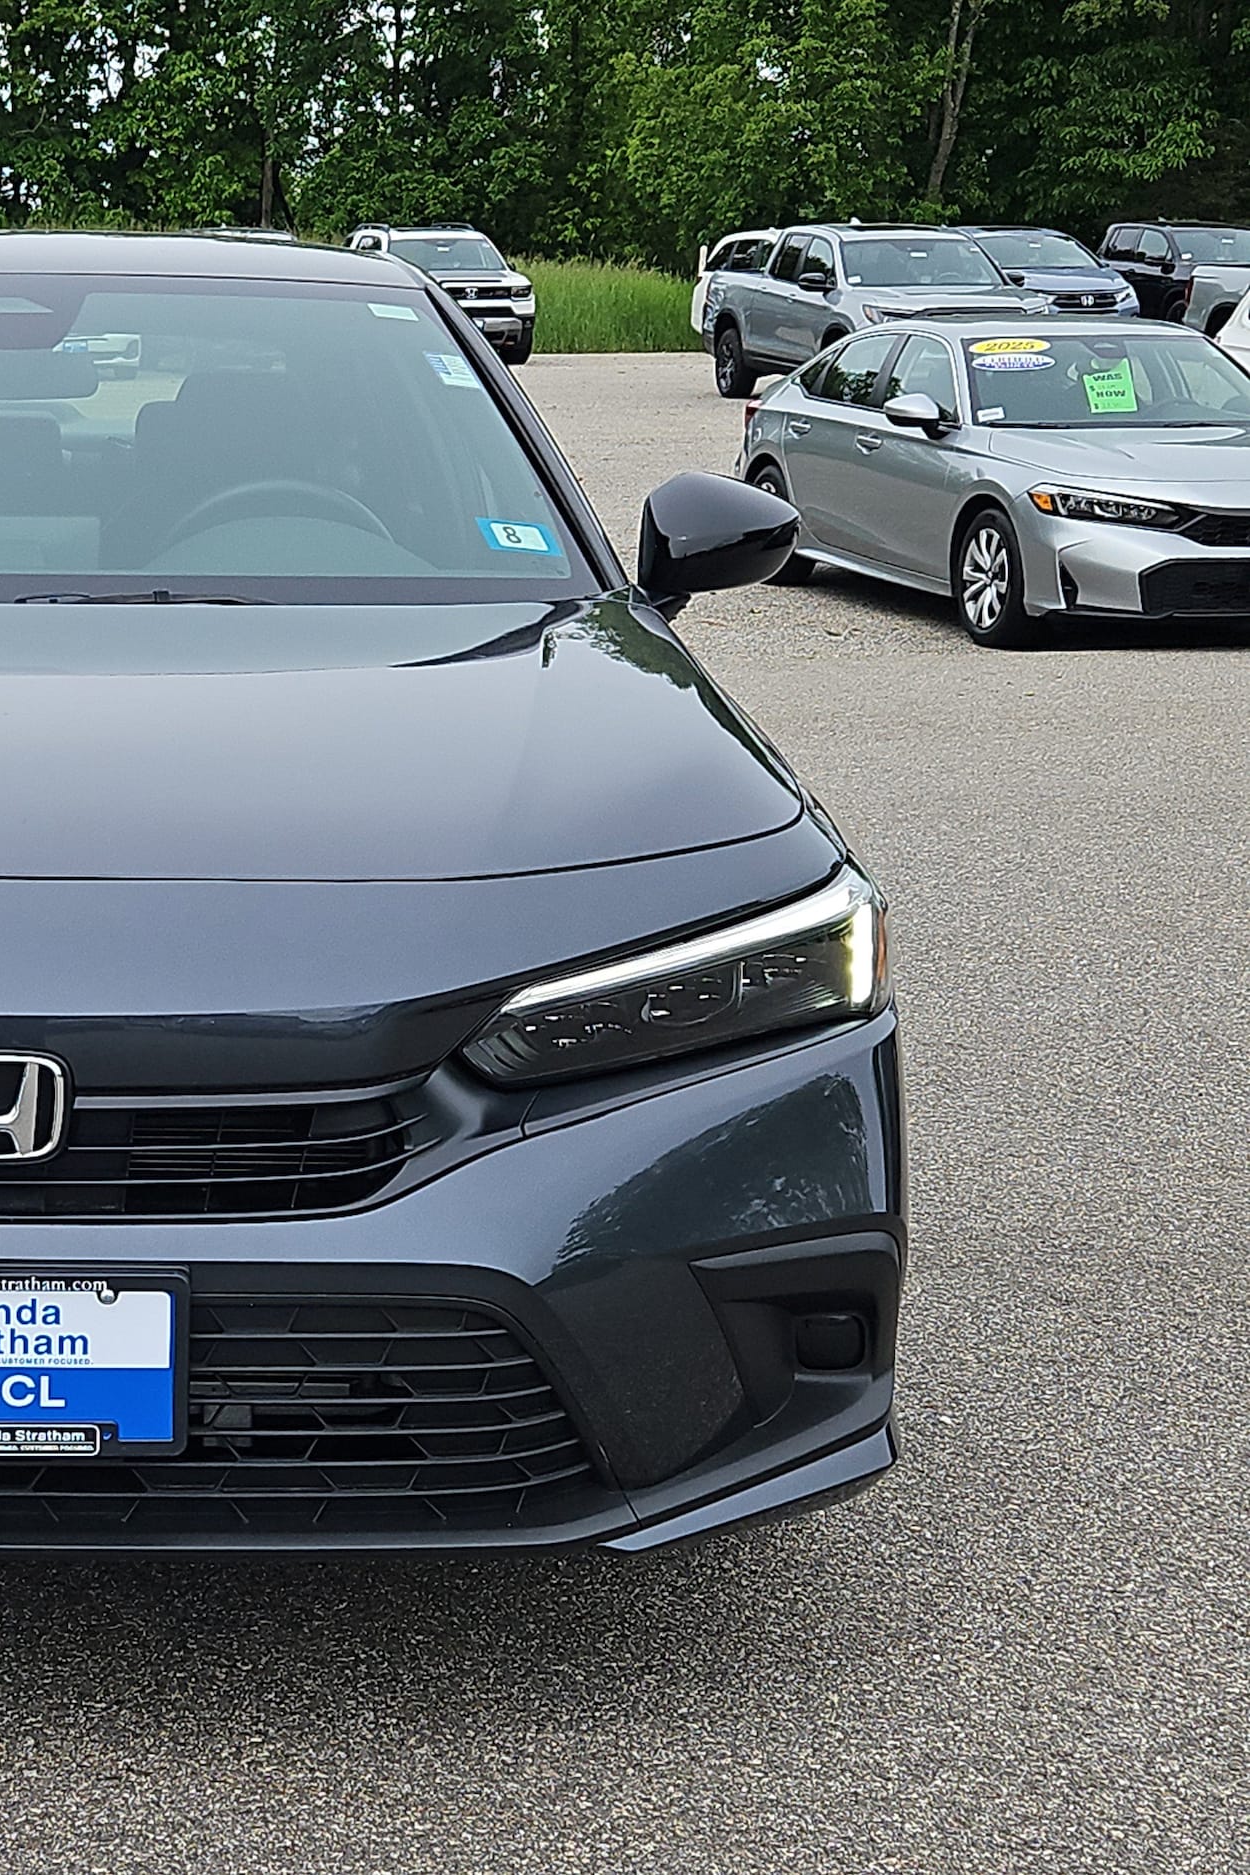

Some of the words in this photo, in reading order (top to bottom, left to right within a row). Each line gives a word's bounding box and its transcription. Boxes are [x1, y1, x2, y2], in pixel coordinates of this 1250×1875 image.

[983, 341, 1035, 352] 2025
[1092, 372, 1123, 382] WAS
[501, 525, 522, 545] 8
[14, 1429, 86, 1441] Stratham
